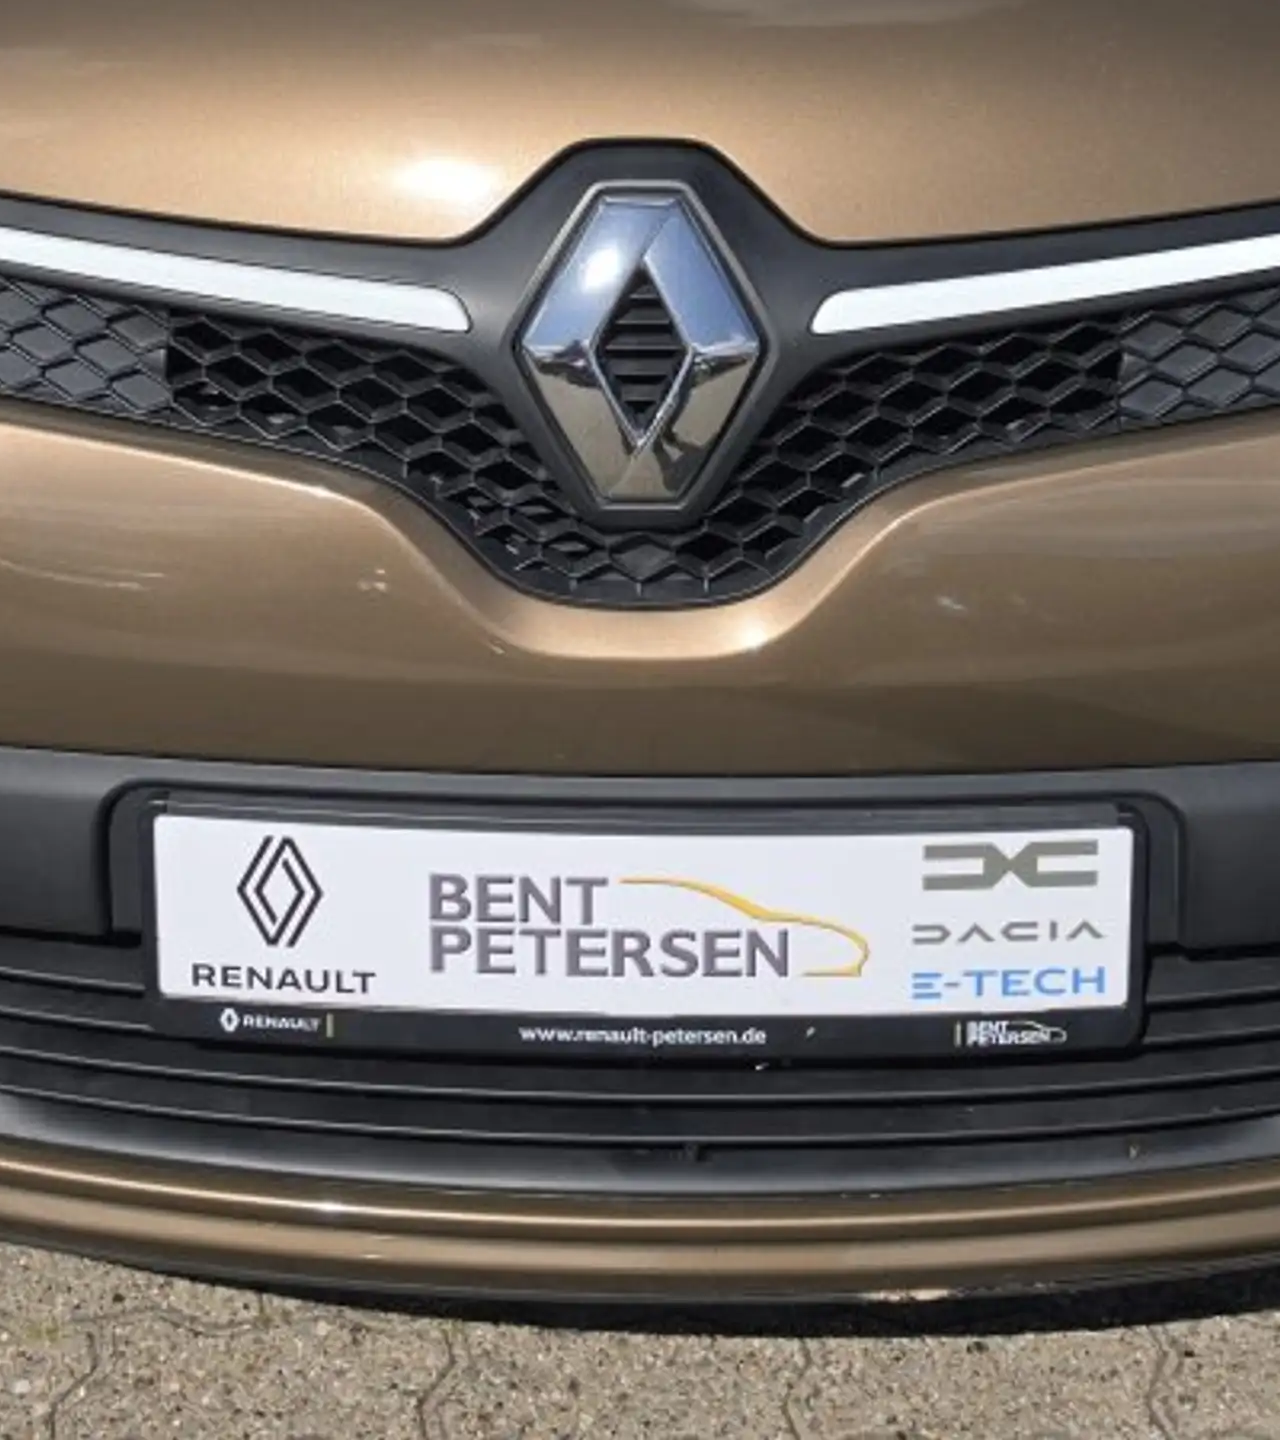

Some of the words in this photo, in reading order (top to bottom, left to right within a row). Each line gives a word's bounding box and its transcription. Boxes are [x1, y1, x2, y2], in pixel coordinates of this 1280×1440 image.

[428, 873, 609, 925] BENT
[911, 919, 1106, 946] DACIA
[428, 925, 790, 978] PETERSEN
[191, 963, 378, 994] RENAULT
[911, 966, 1106, 1000] E-TECH
[243, 1013, 320, 1032] RENAULT
[518, 1026, 768, 1049] www.renault-petersen.de
